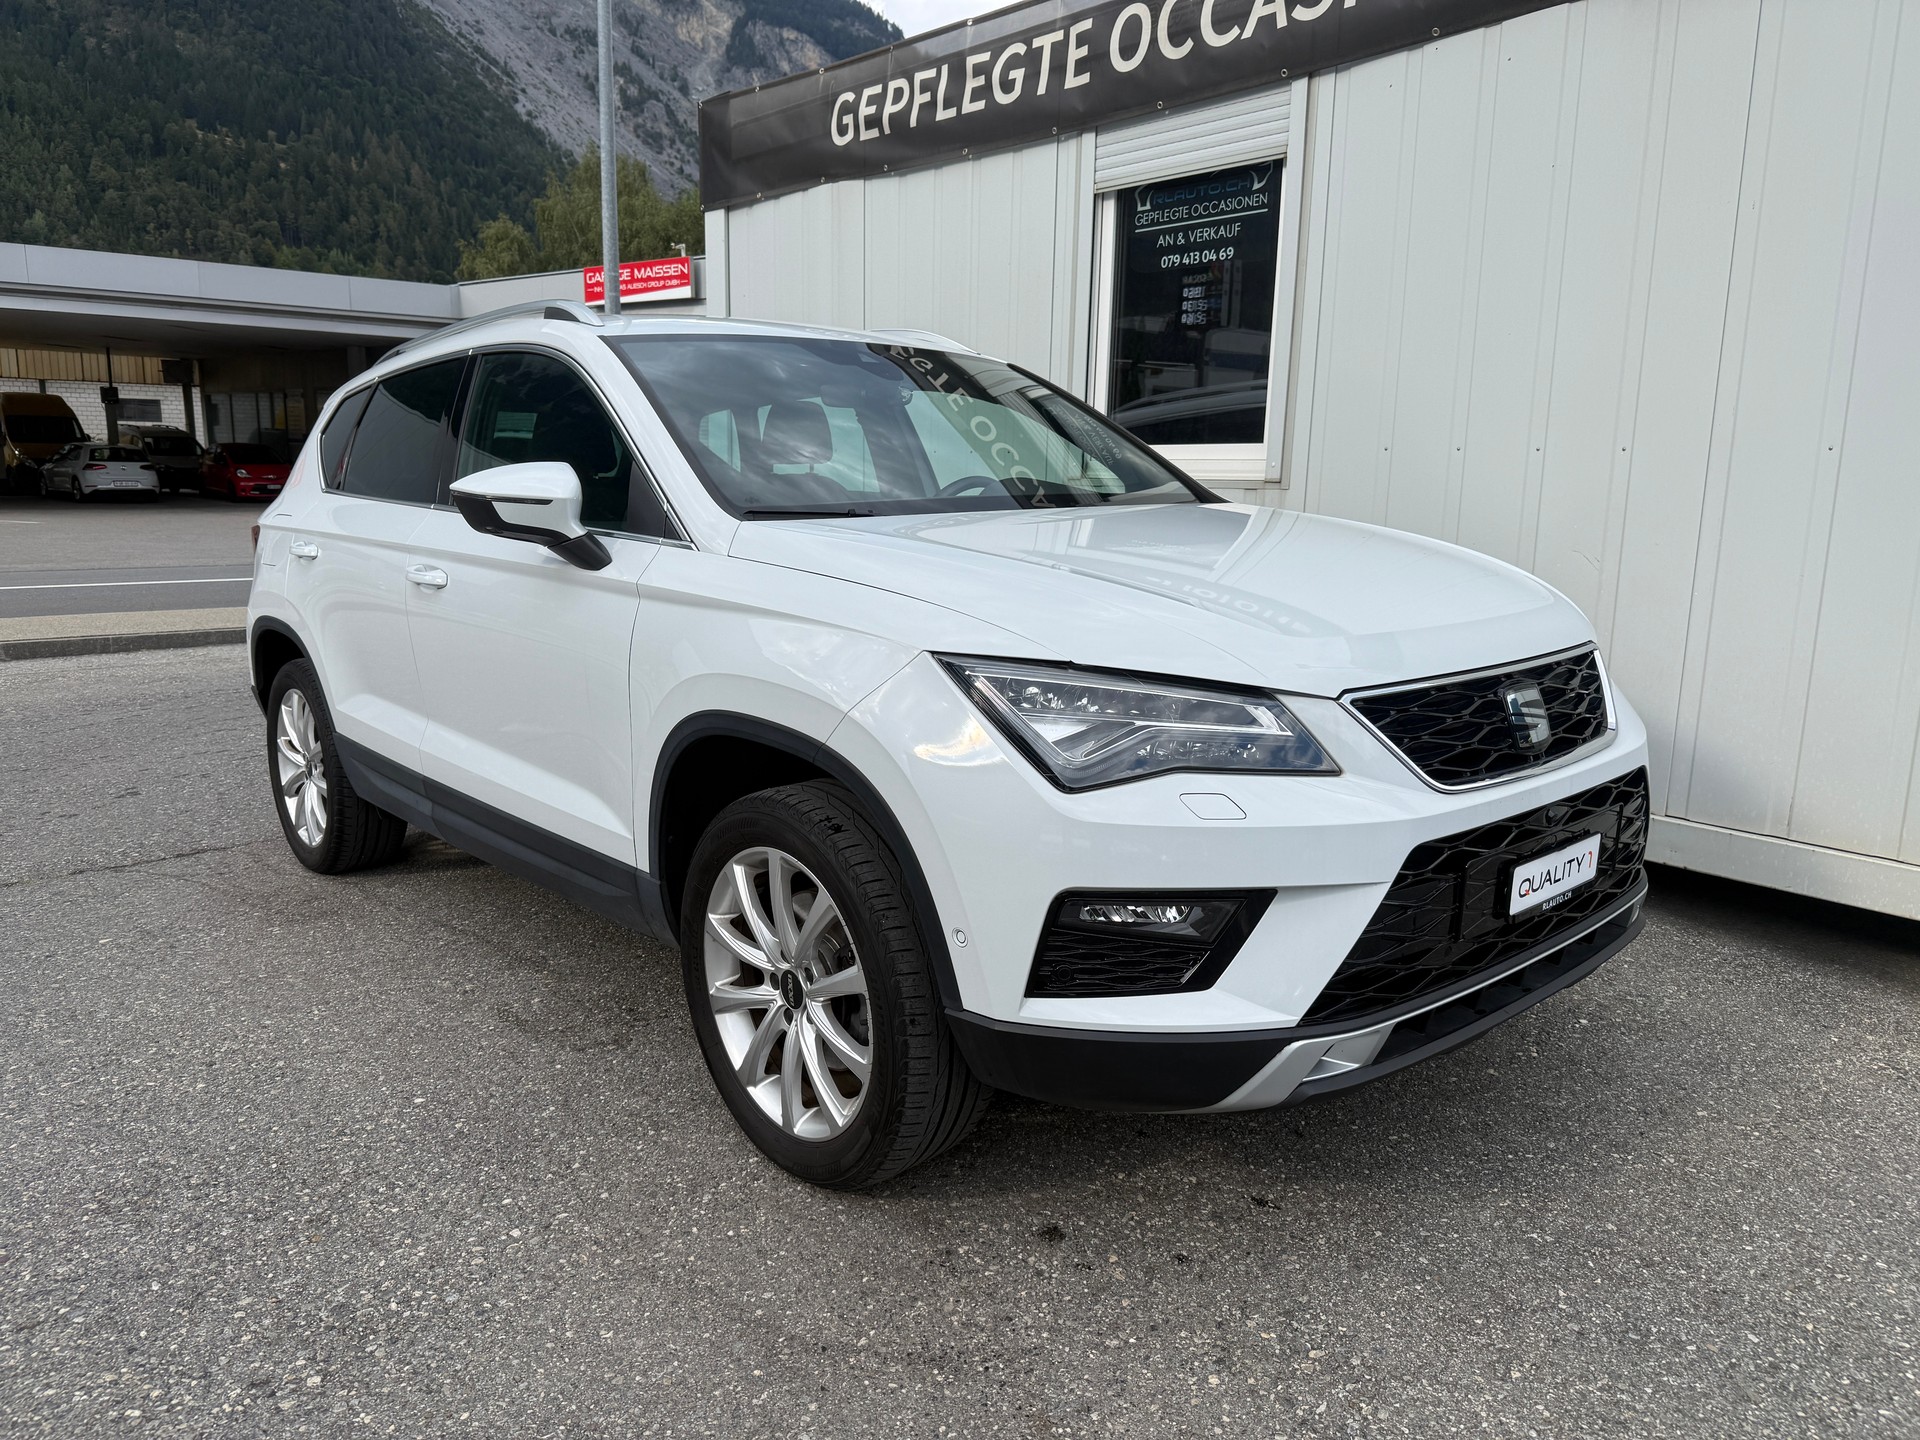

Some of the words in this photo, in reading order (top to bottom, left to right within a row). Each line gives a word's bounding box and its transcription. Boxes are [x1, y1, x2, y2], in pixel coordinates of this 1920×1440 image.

[830, 17, 1093, 147] GEPFLEGTE
[1152, 178, 1250, 205] RLAUTO.CH
[1134, 205, 1189, 226] GEPFLEGTE
[1191, 192, 1269, 216] OCCASIONEN
[1156, 232, 1174, 248] AN
[1176, 232, 1186, 245] &
[1188, 222, 1242, 243] VERKAUF
[1160, 253, 1180, 269] 079
[1182, 251, 1200, 266] 413
[1201, 249, 1217, 263] 04
[1218, 246, 1235, 260] 69
[586, 268, 631, 284] GAGE
[634, 262, 688, 279] MAISSEN
[1542, 890, 1573, 911] RLAUTO.CH
